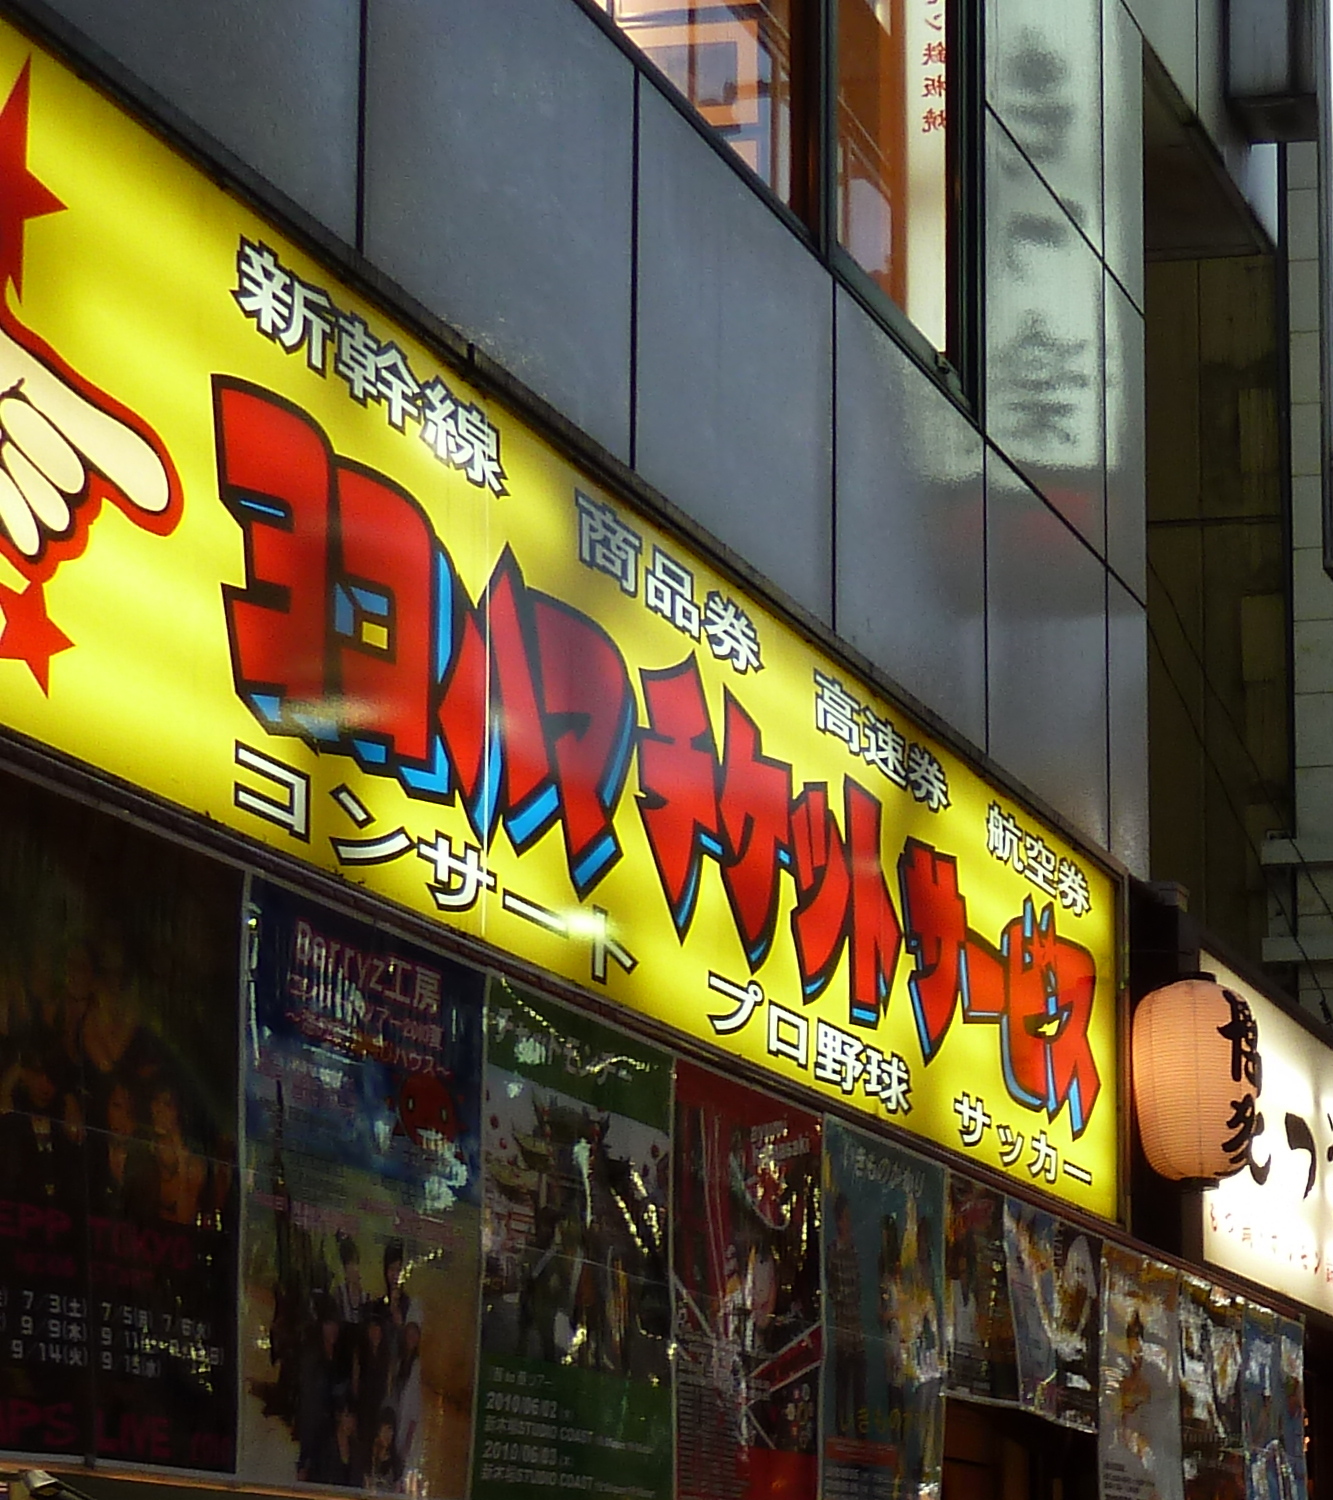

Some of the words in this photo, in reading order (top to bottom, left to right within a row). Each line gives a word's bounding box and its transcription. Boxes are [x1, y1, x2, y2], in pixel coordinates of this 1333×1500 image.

[230, 234, 508, 498] 新幹線
[575, 489, 763, 674] 商品券
[813, 669, 950, 813] 高速券
[233, 741, 637, 981] コンサート
[986, 802, 1092, 916] 航空券
[707, 970, 913, 1116] プロ野球
[953, 1092, 1093, 1188] サッカー
